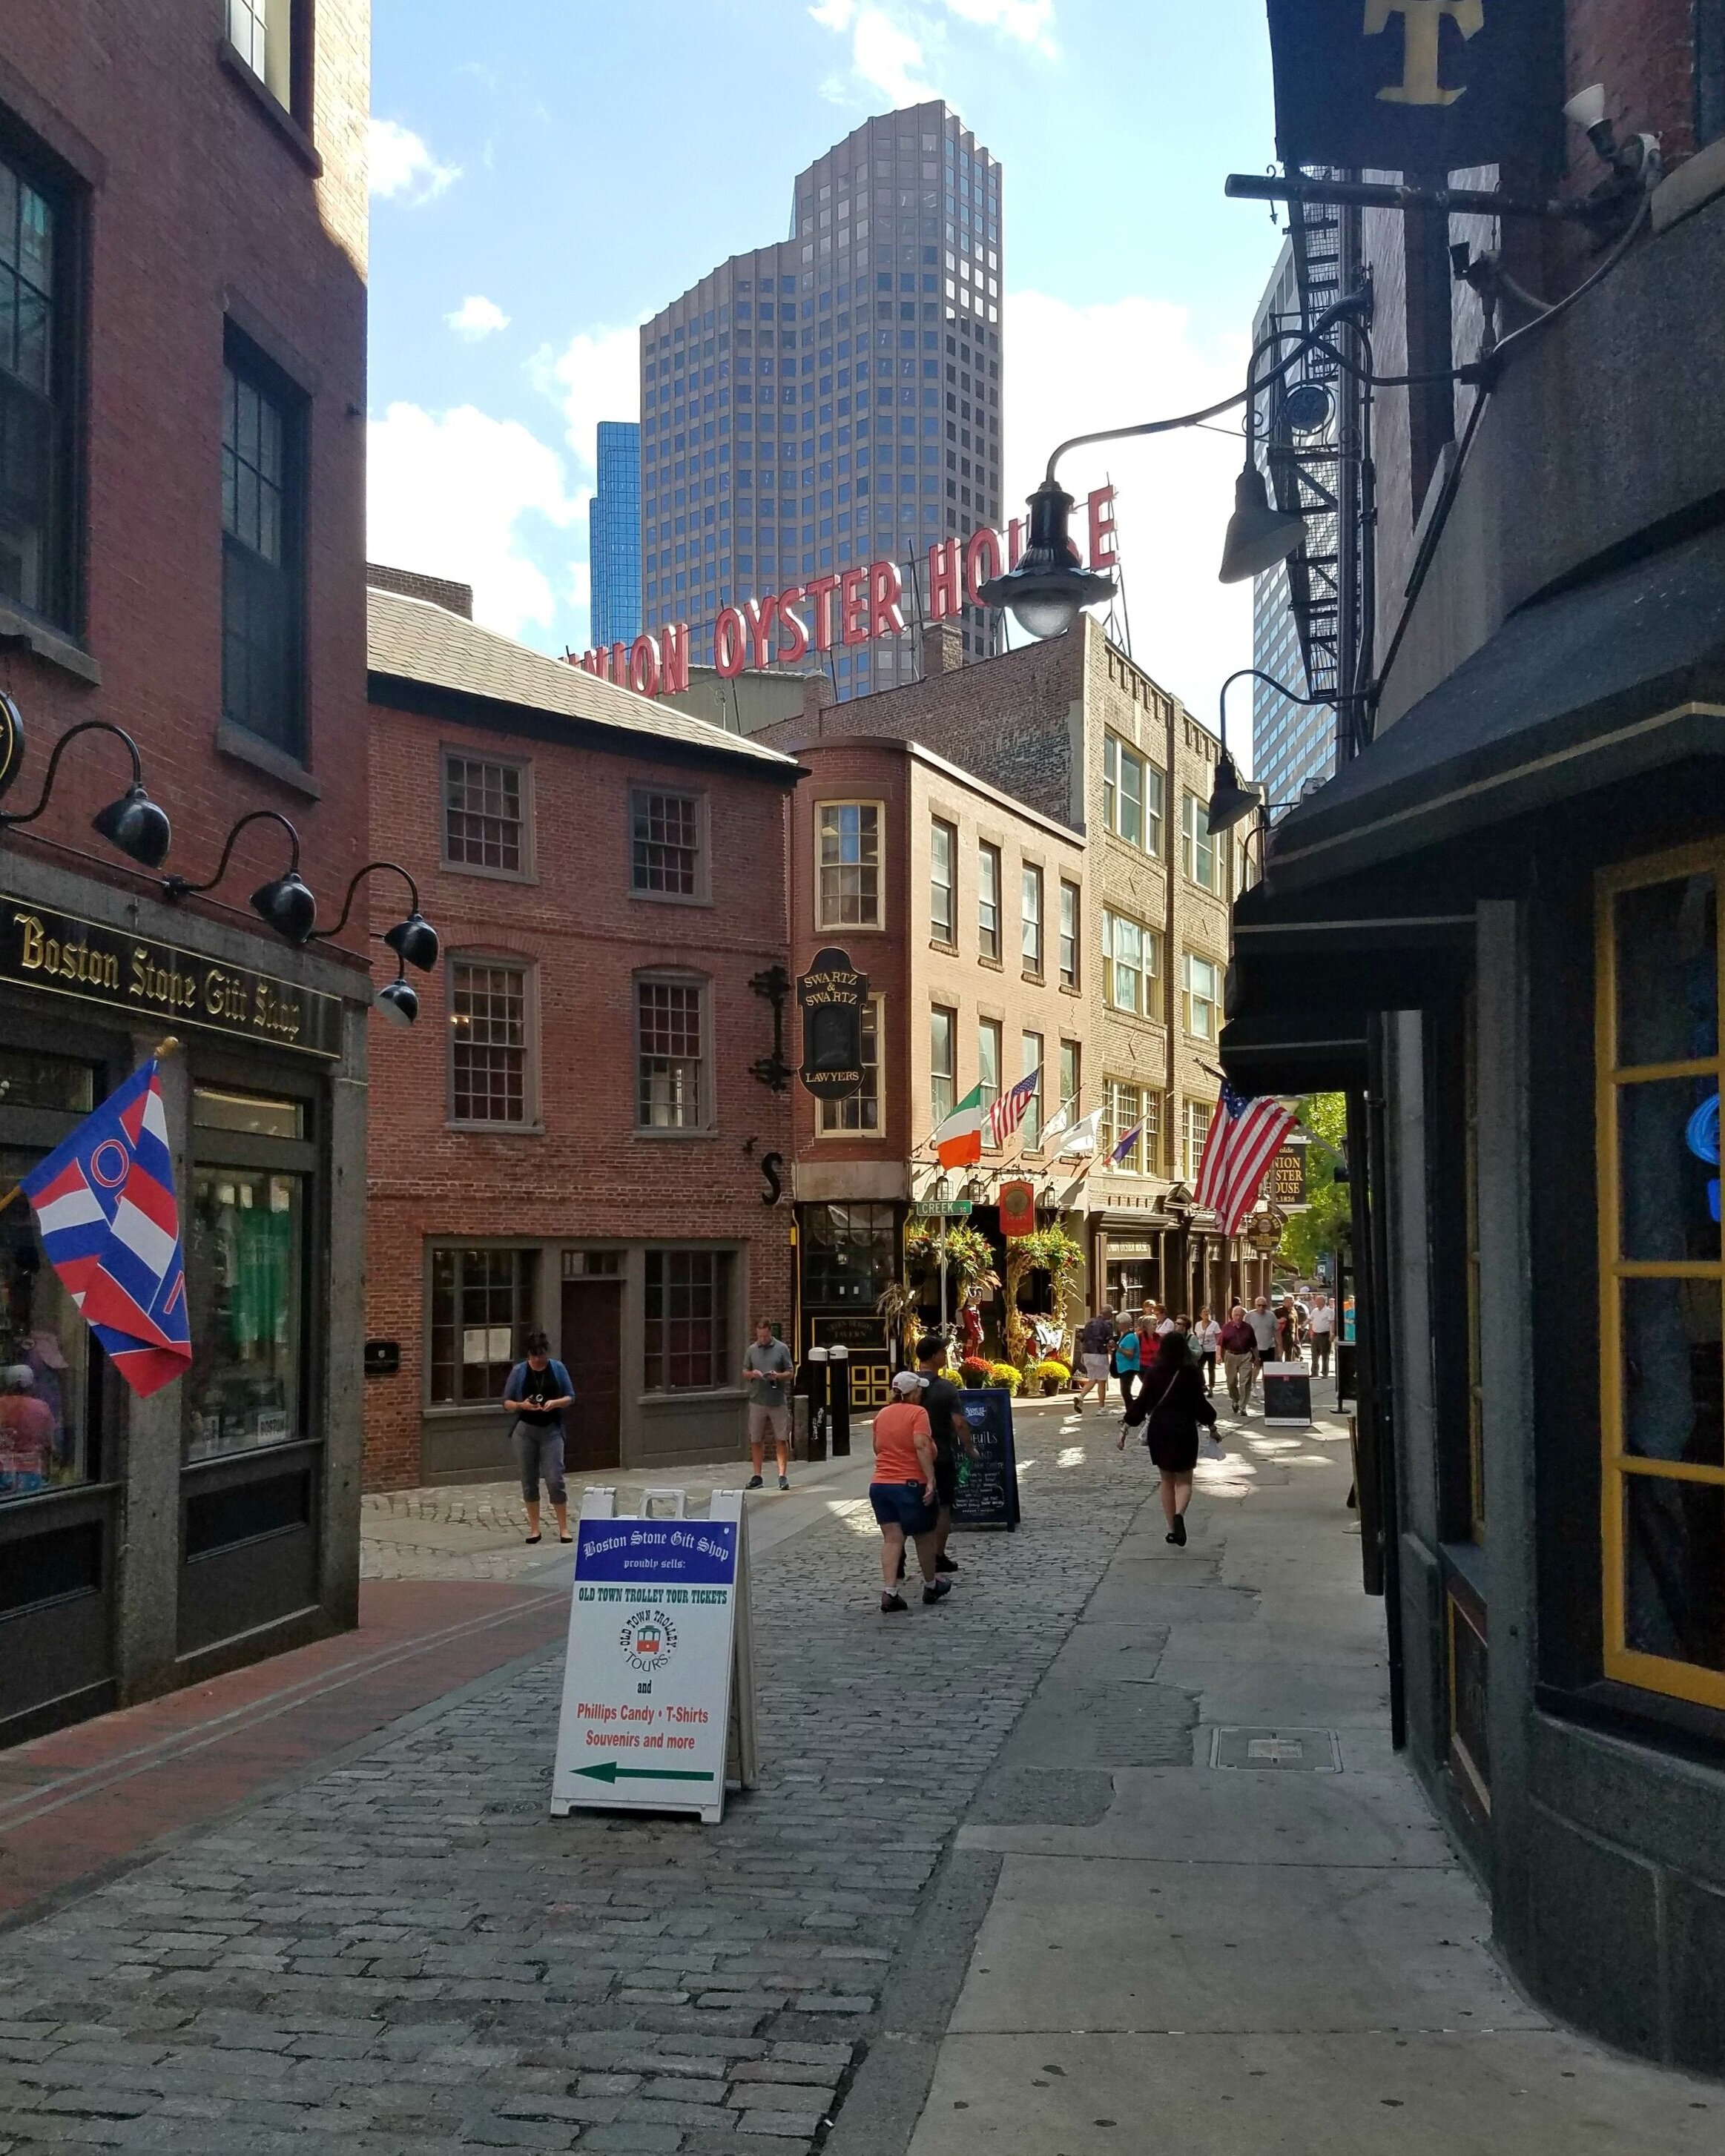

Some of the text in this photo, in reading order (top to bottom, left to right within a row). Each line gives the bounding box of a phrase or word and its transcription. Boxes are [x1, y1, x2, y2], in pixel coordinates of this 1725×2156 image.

[558, 485, 1119, 701] ION OYSTER HOE
[13, 913, 300, 1042] Boston Stone Gift Shop
[804, 971, 858, 988] SWARTZ
[827, 982, 836, 992] &
[805, 991, 858, 1006] SWARTZ
[805, 1071, 860, 1082] LAWYERS
[1273, 1157, 1301, 1168] NION
[1264, 1170, 1304, 1182] OSTER
[922, 1203, 954, 1214] CREEK
[583, 1530, 729, 1561] Boston Stone Gift Shop
[624, 1558, 686, 1570] proudly sells:
[578, 1587, 728, 1604] OLD TOWN TROLLEY TOUR TICKETS
[620, 1610, 677, 1647] OLD TOWN TROLLEY
[626, 1651, 668, 1672] TOURS
[637, 1679, 652, 1694] and
[577, 1703, 709, 1725] Phillips Candy T-Shirts
[586, 1730, 695, 1749] Souvenirs and more
